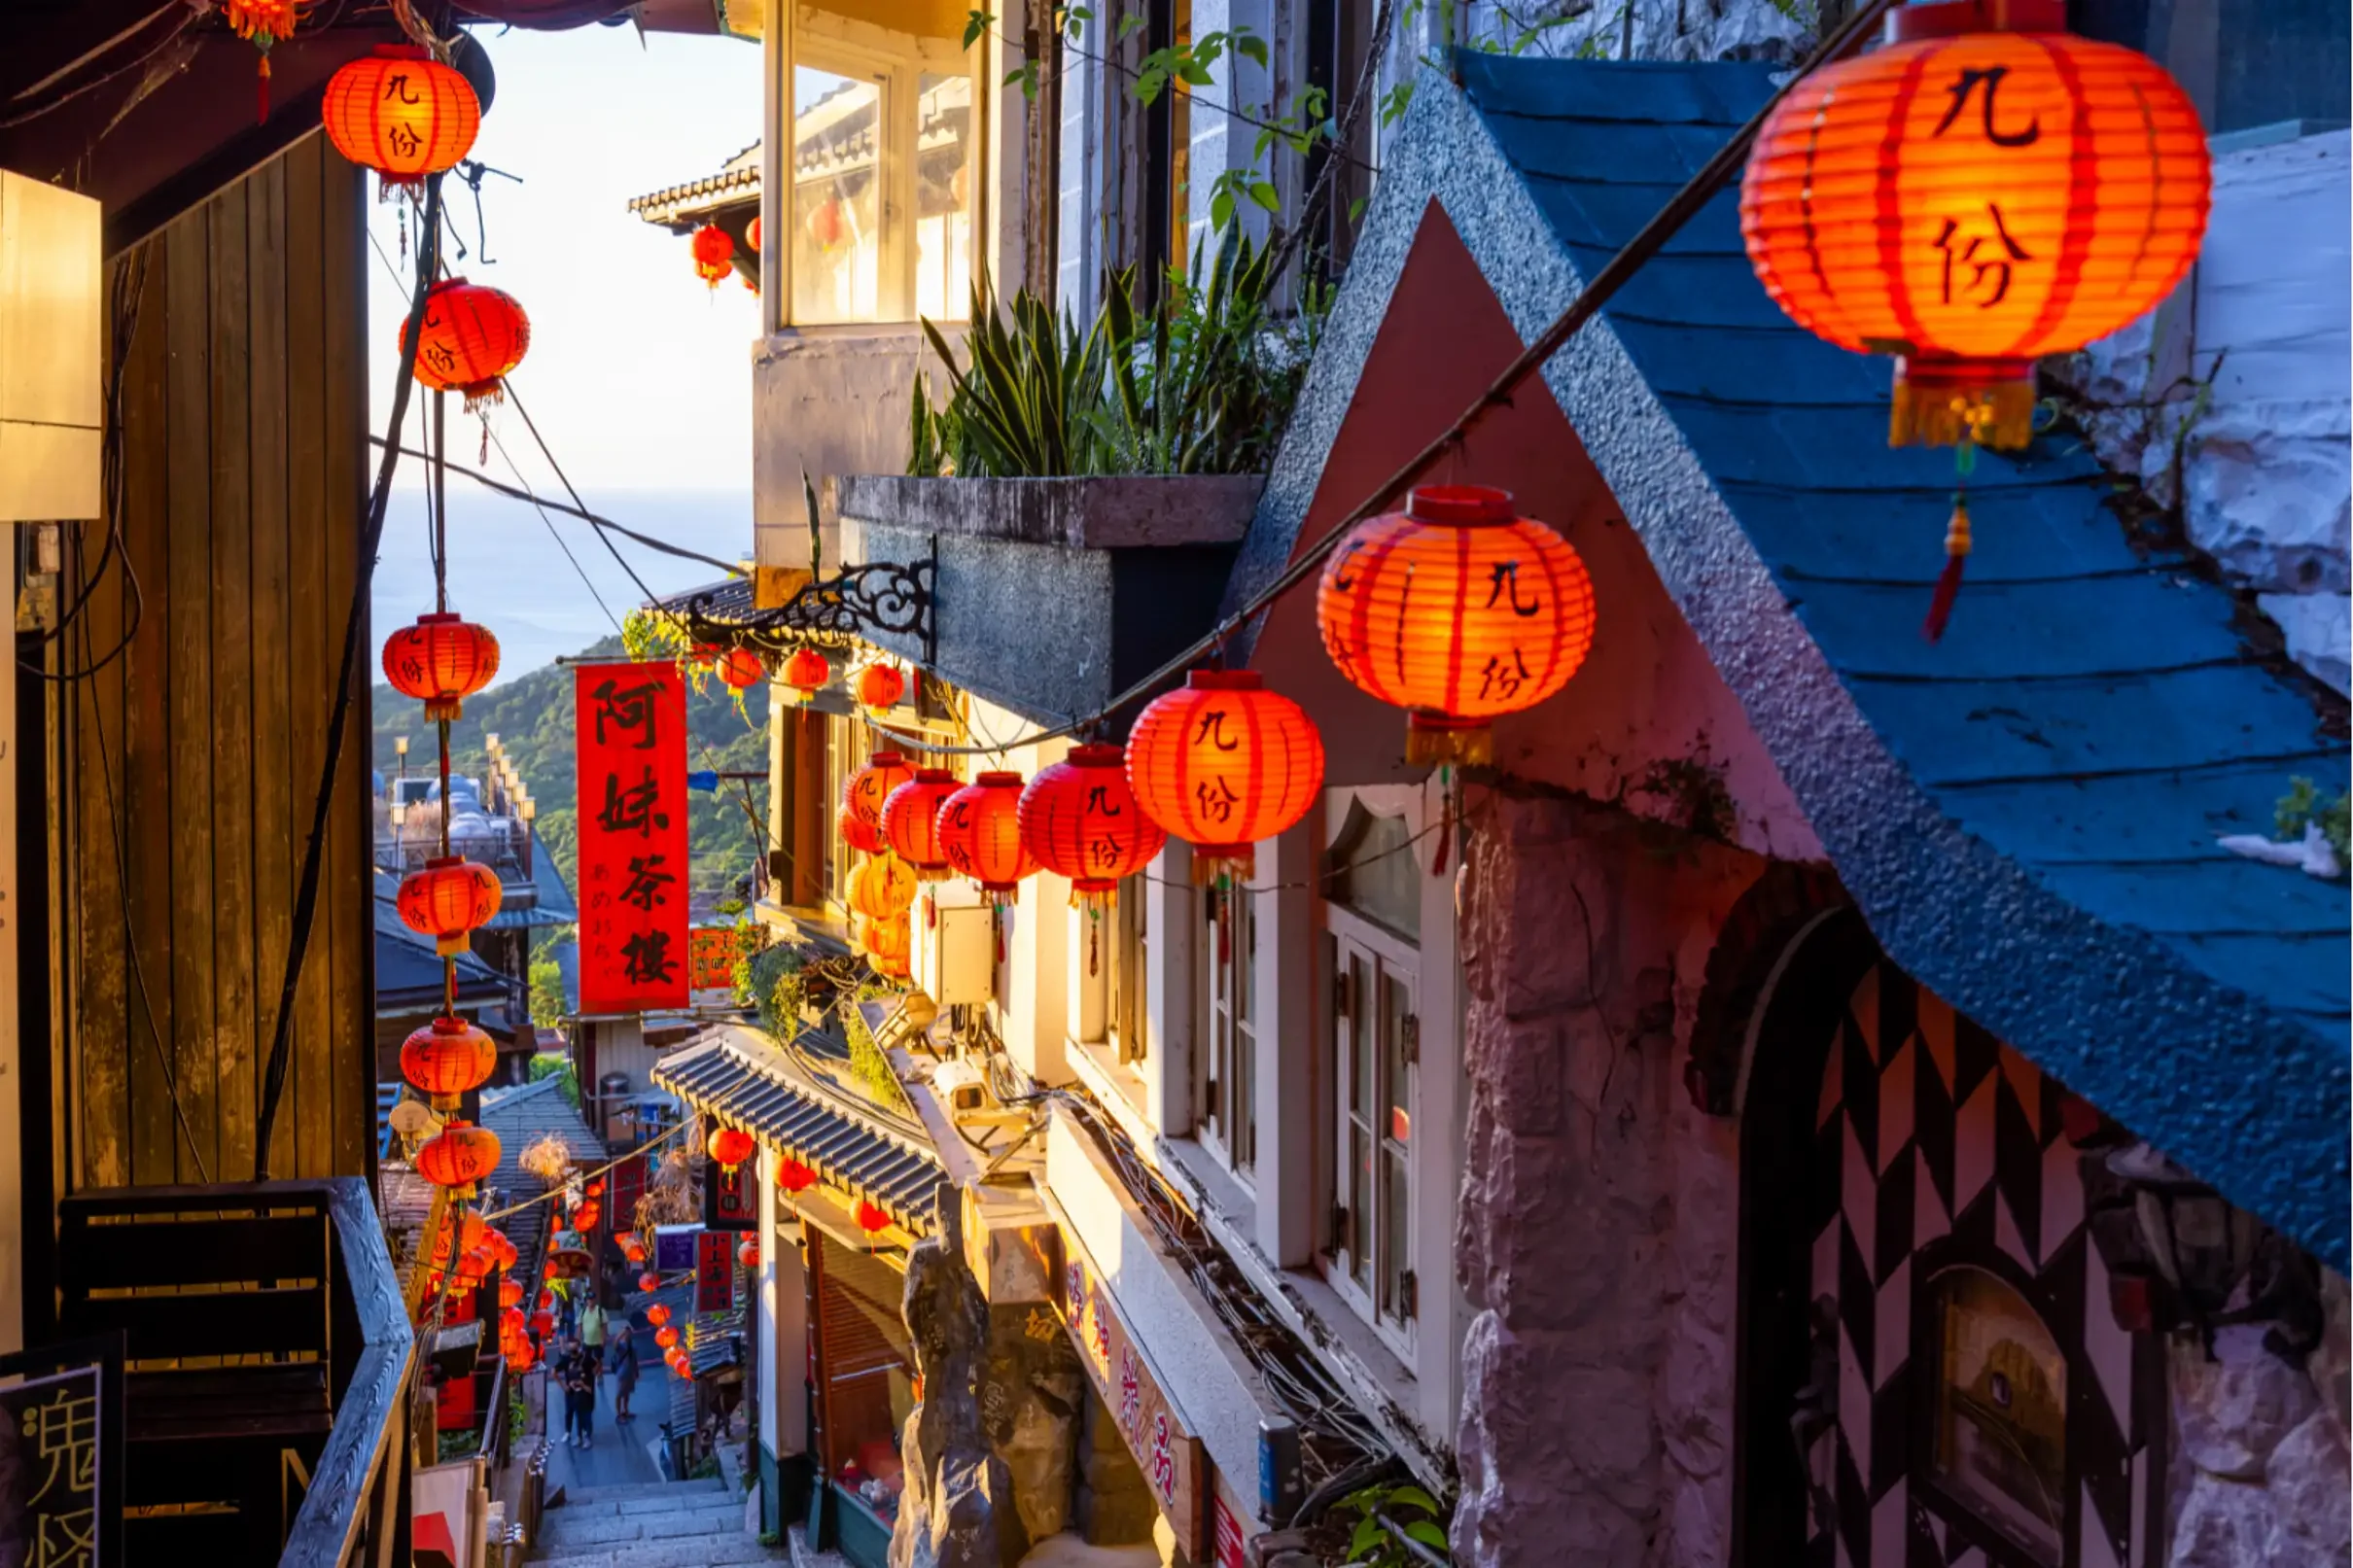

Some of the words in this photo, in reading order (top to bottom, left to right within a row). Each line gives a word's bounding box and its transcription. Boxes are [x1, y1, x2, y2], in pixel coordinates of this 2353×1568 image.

[384, 74, 423, 158] 九份
[1931, 64, 2040, 309] 九份
[401, 624, 425, 684] 九份
[1478, 560, 1539, 703] 九份
[859, 775, 880, 825] 九份
[1193, 710, 1241, 824] 九份
[590, 679, 679, 986] 阿妹茶樓
[947, 800, 971, 872] 九份
[1086, 784, 1124, 870] 九份
[408, 878, 428, 929] 九份
[474, 870, 492, 923] 九份
[412, 1042, 433, 1089] 九份
[457, 1132, 477, 1175] 九份
